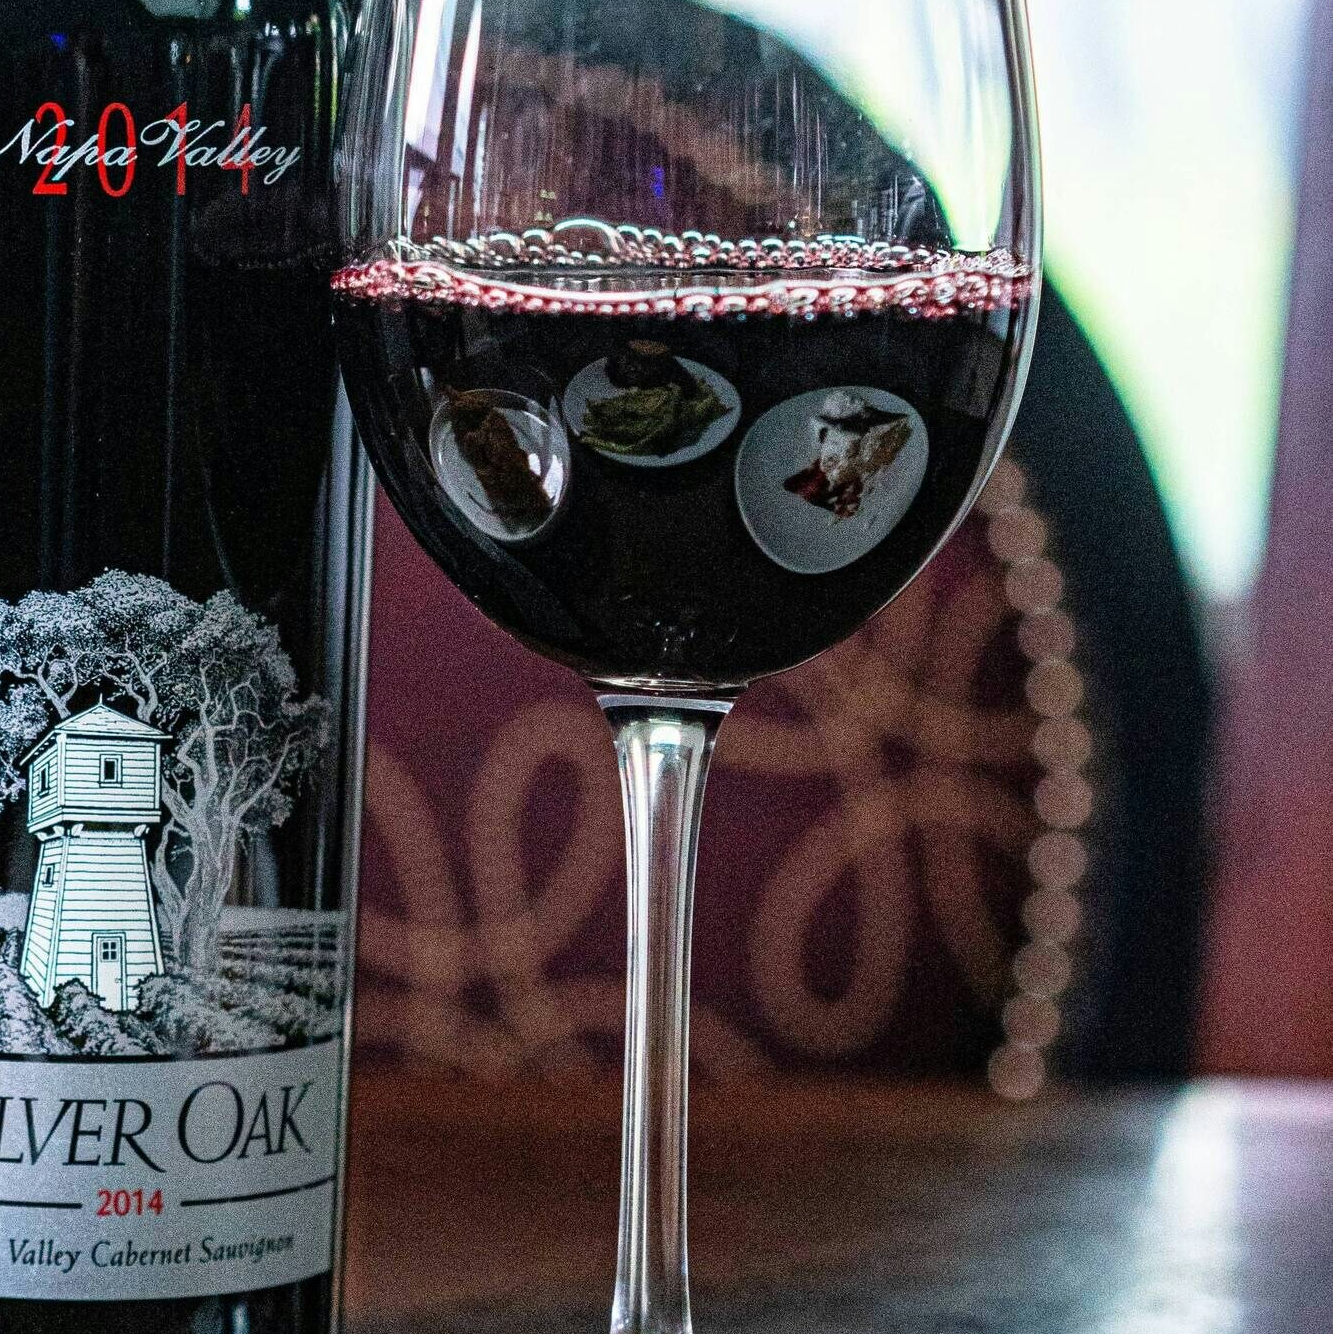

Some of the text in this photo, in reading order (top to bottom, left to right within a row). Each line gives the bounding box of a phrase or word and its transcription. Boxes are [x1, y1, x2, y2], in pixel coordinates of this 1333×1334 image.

[32, 101, 255, 197] 2014
[140, 119, 302, 185] Valley
[178, 1080, 313, 1163] OAK
[96, 1187, 164, 1218] 2014
[9, 1239, 81, 1273] Valley
[91, 1239, 192, 1268] Cabernet
[199, 1233, 295, 1264] Sauvignon
